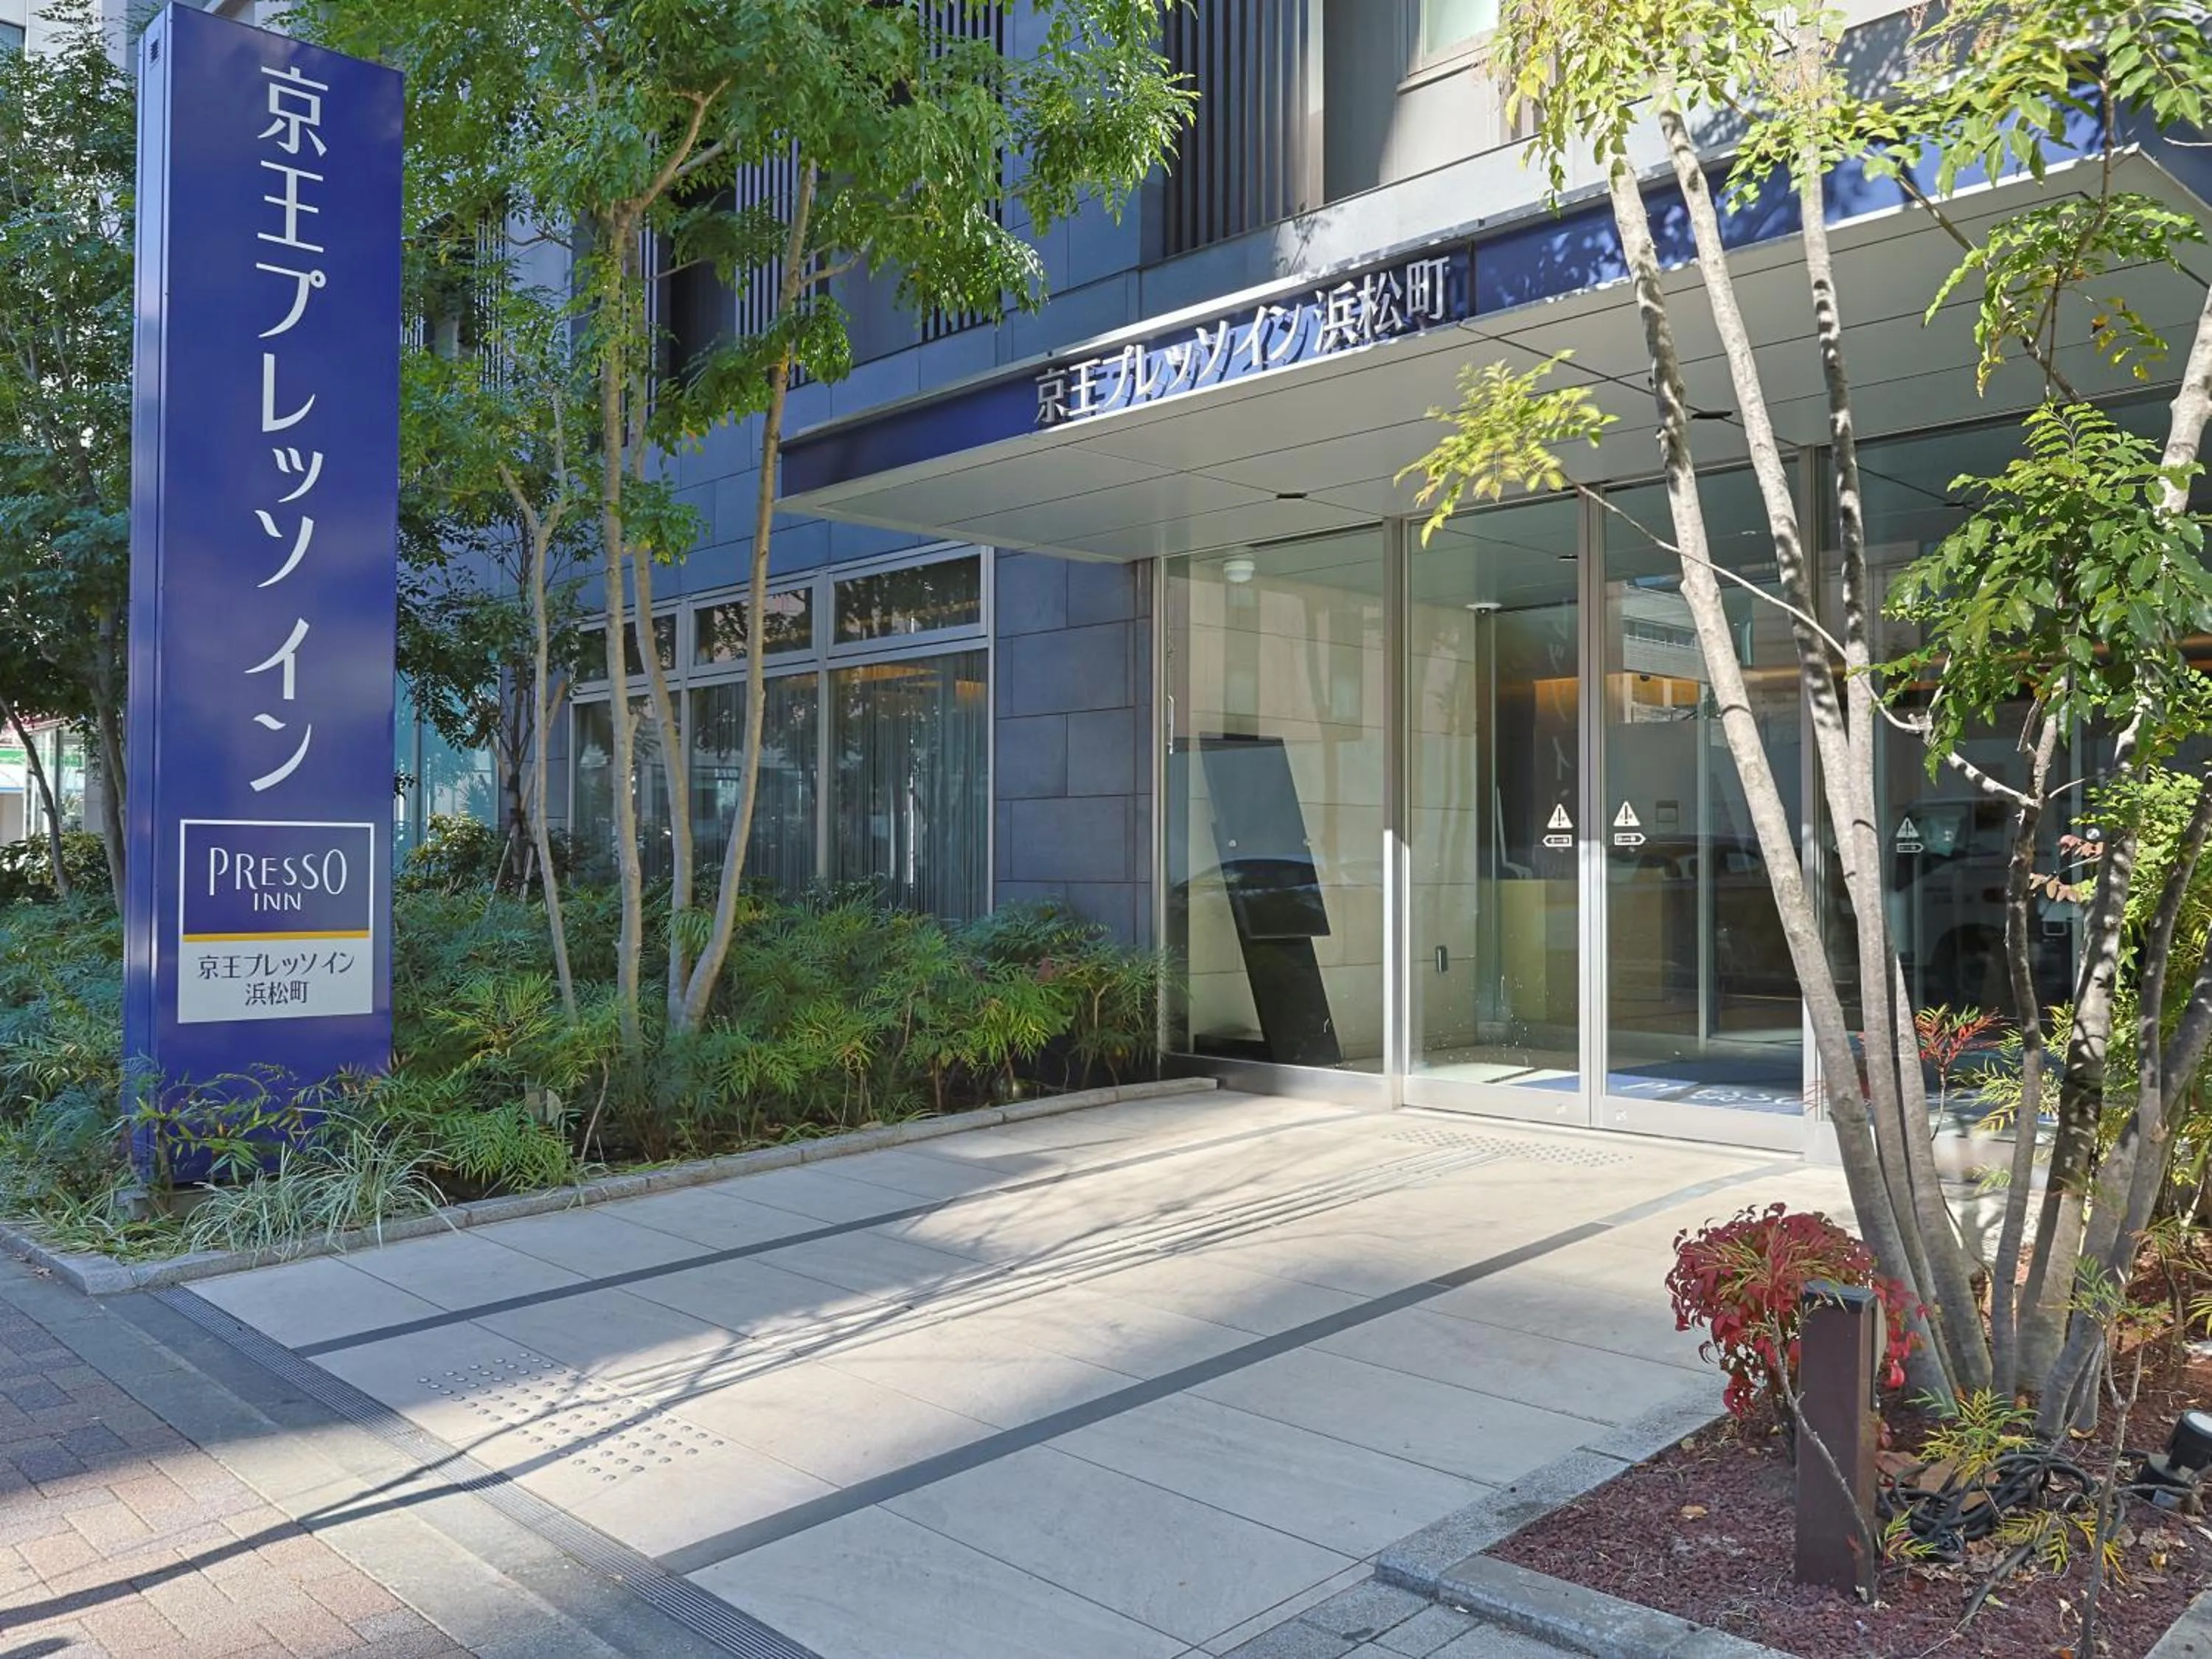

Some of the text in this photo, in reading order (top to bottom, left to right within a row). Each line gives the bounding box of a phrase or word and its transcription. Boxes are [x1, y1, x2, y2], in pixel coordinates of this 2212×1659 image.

[244, 65, 330, 793] 京王プレッソイン
[209, 846, 347, 896] PRESSO
[254, 892, 302, 911] INN
[198, 951, 355, 979] 京王プレッソイン
[245, 980, 310, 1006] 浜松町
